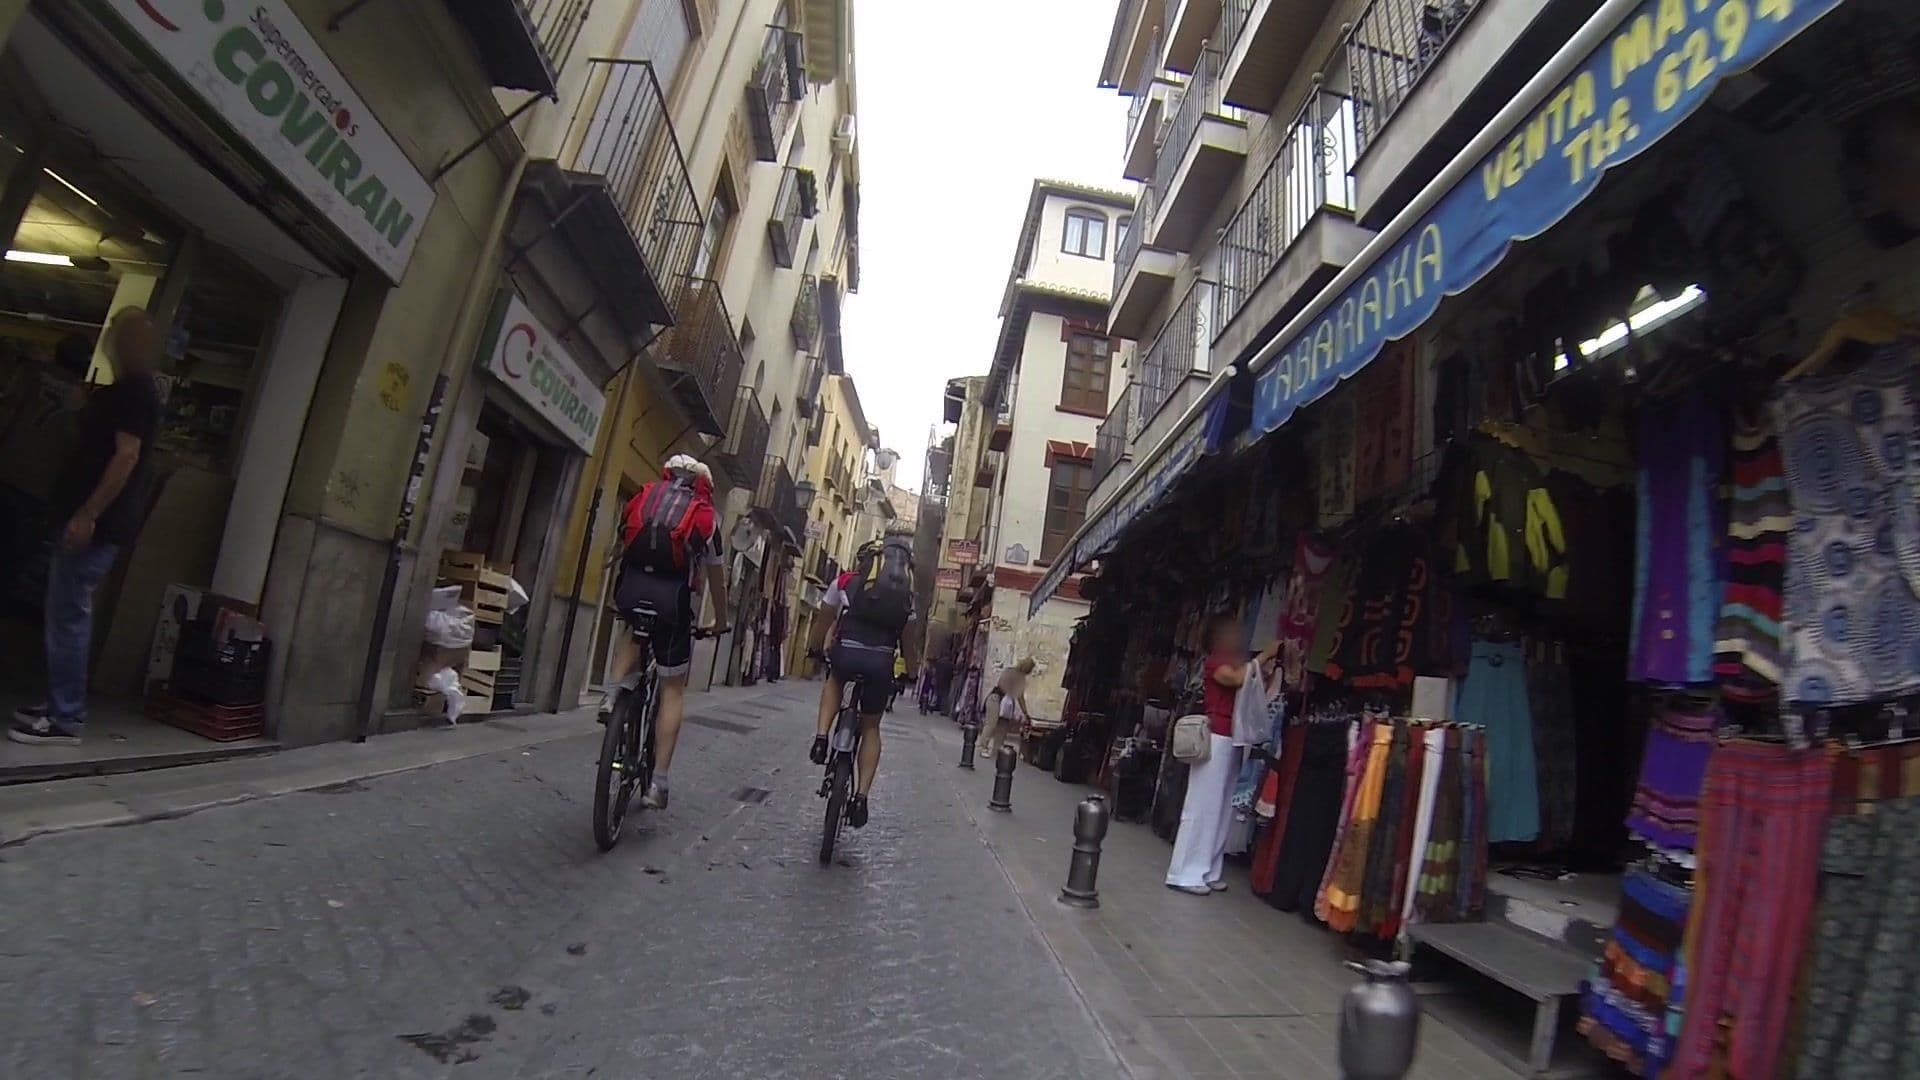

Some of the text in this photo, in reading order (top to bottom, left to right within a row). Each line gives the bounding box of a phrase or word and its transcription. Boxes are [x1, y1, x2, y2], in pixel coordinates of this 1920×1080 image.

[213, 26, 414, 248] COVIRAN
[249, 6, 359, 137] Supermercados
[1483, 0, 1709, 201] VENTA MA
[530, 358, 598, 437] COVIRAN
